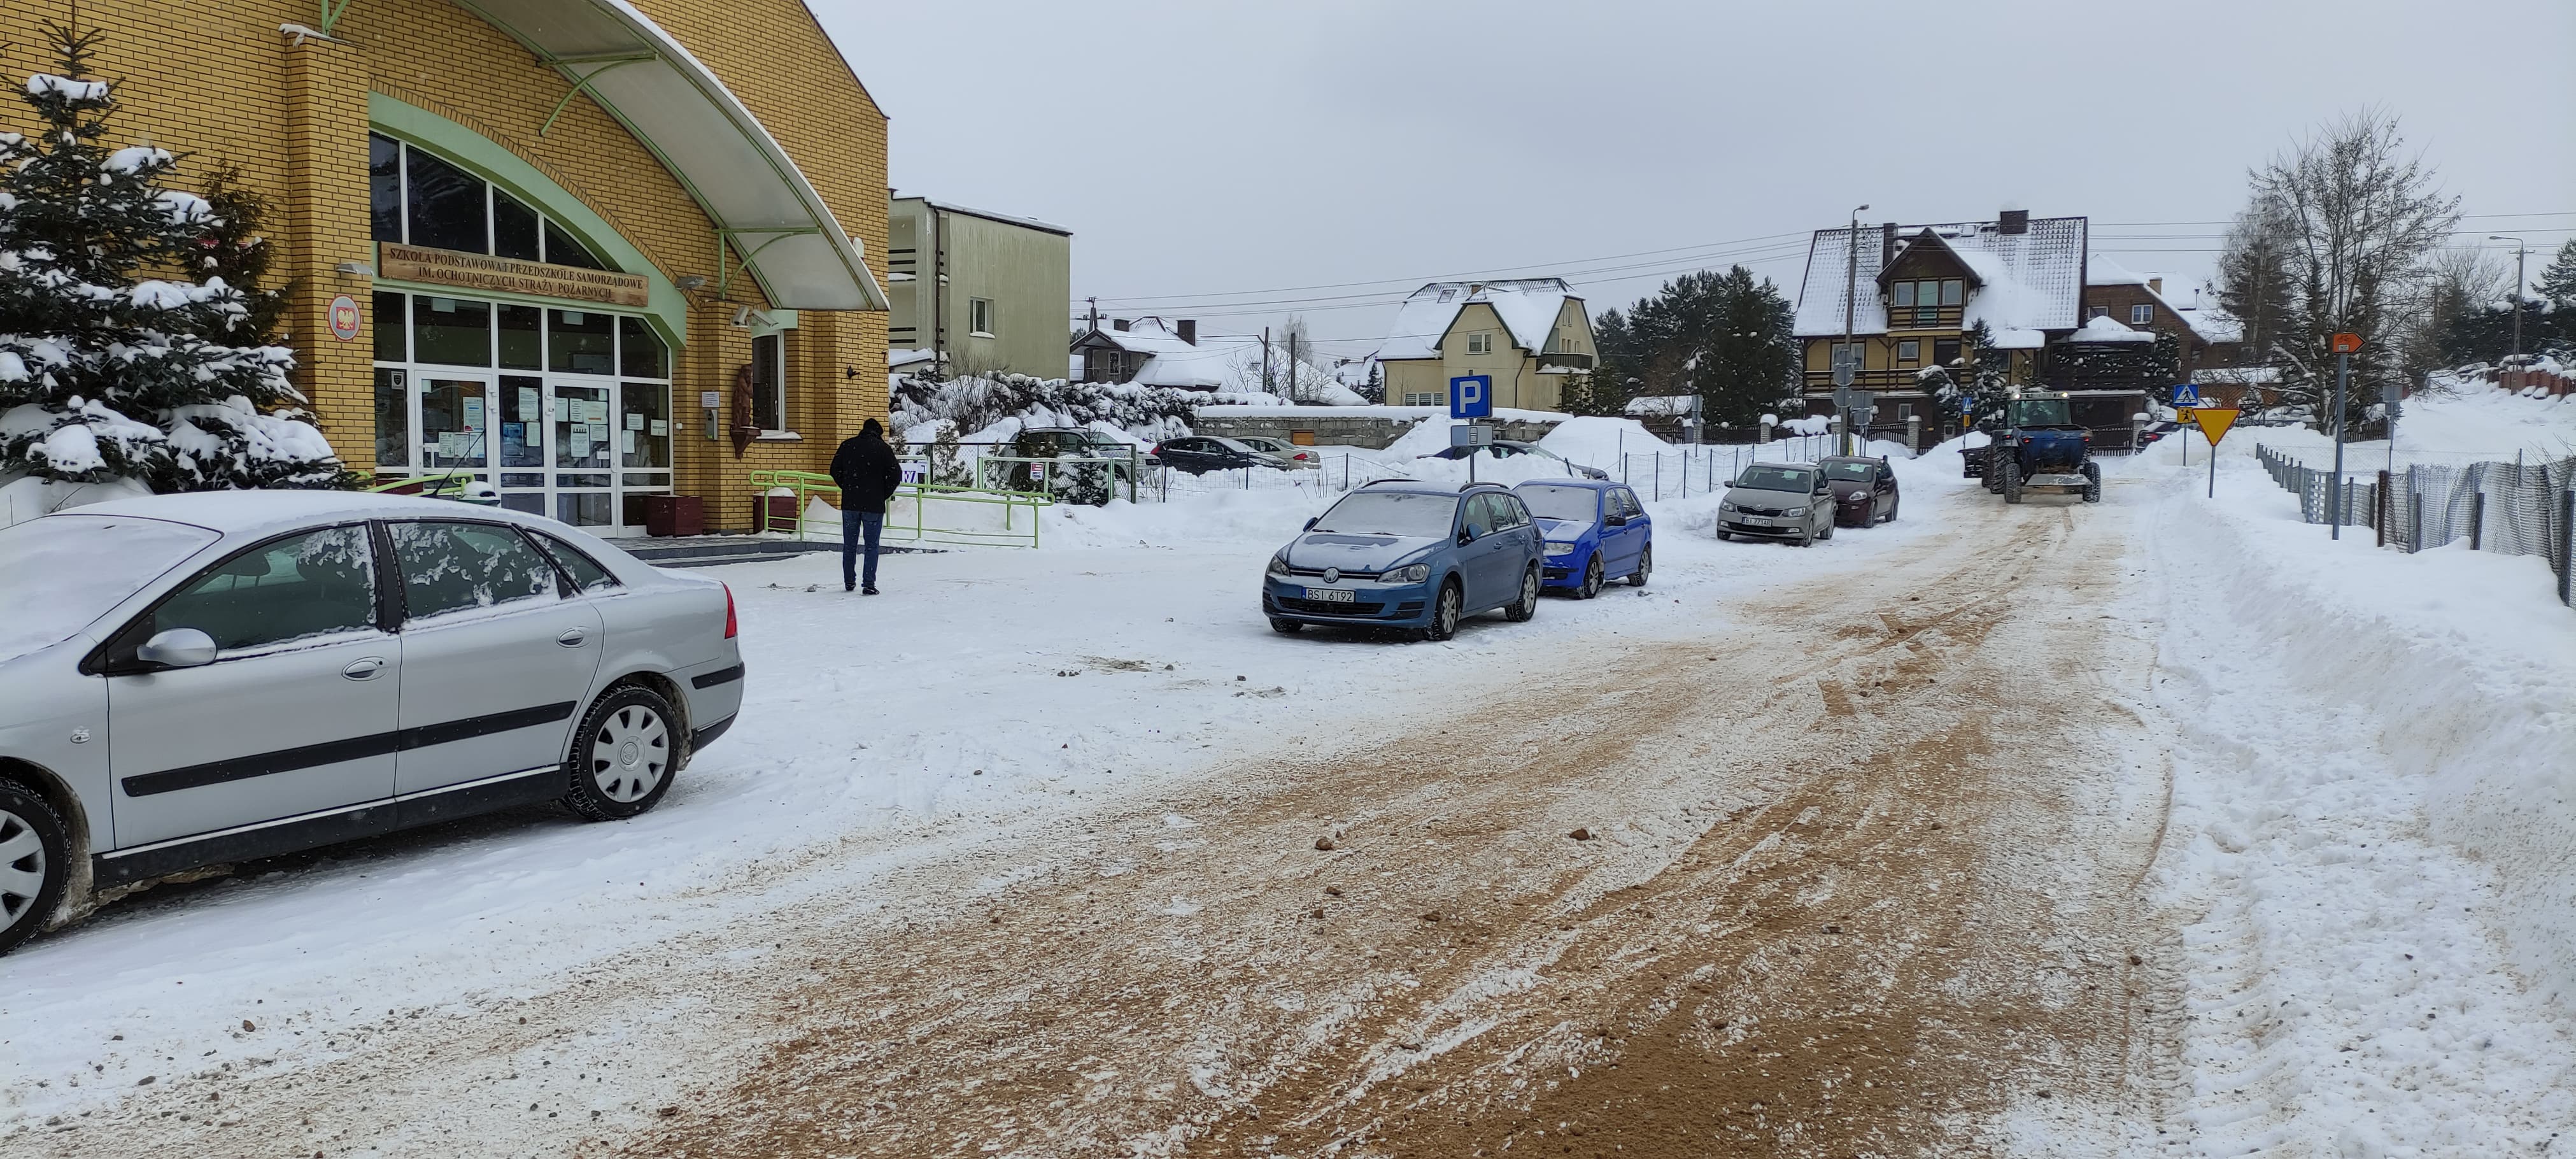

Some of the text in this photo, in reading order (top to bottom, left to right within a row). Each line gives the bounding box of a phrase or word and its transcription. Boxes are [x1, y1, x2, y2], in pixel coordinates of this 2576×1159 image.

[419, 266, 612, 299] IM. OCHOTNICZYCH STRAŻY POŻARNYCH
[434, 254, 504, 272] PODSTAWOWA
[510, 264, 575, 281] PRZEDSZKOLE
[576, 272, 643, 289] SAMORZĄDOWE
[1459, 380, 1481, 413] P
[1308, 589, 1352, 602] BSI 6T92
